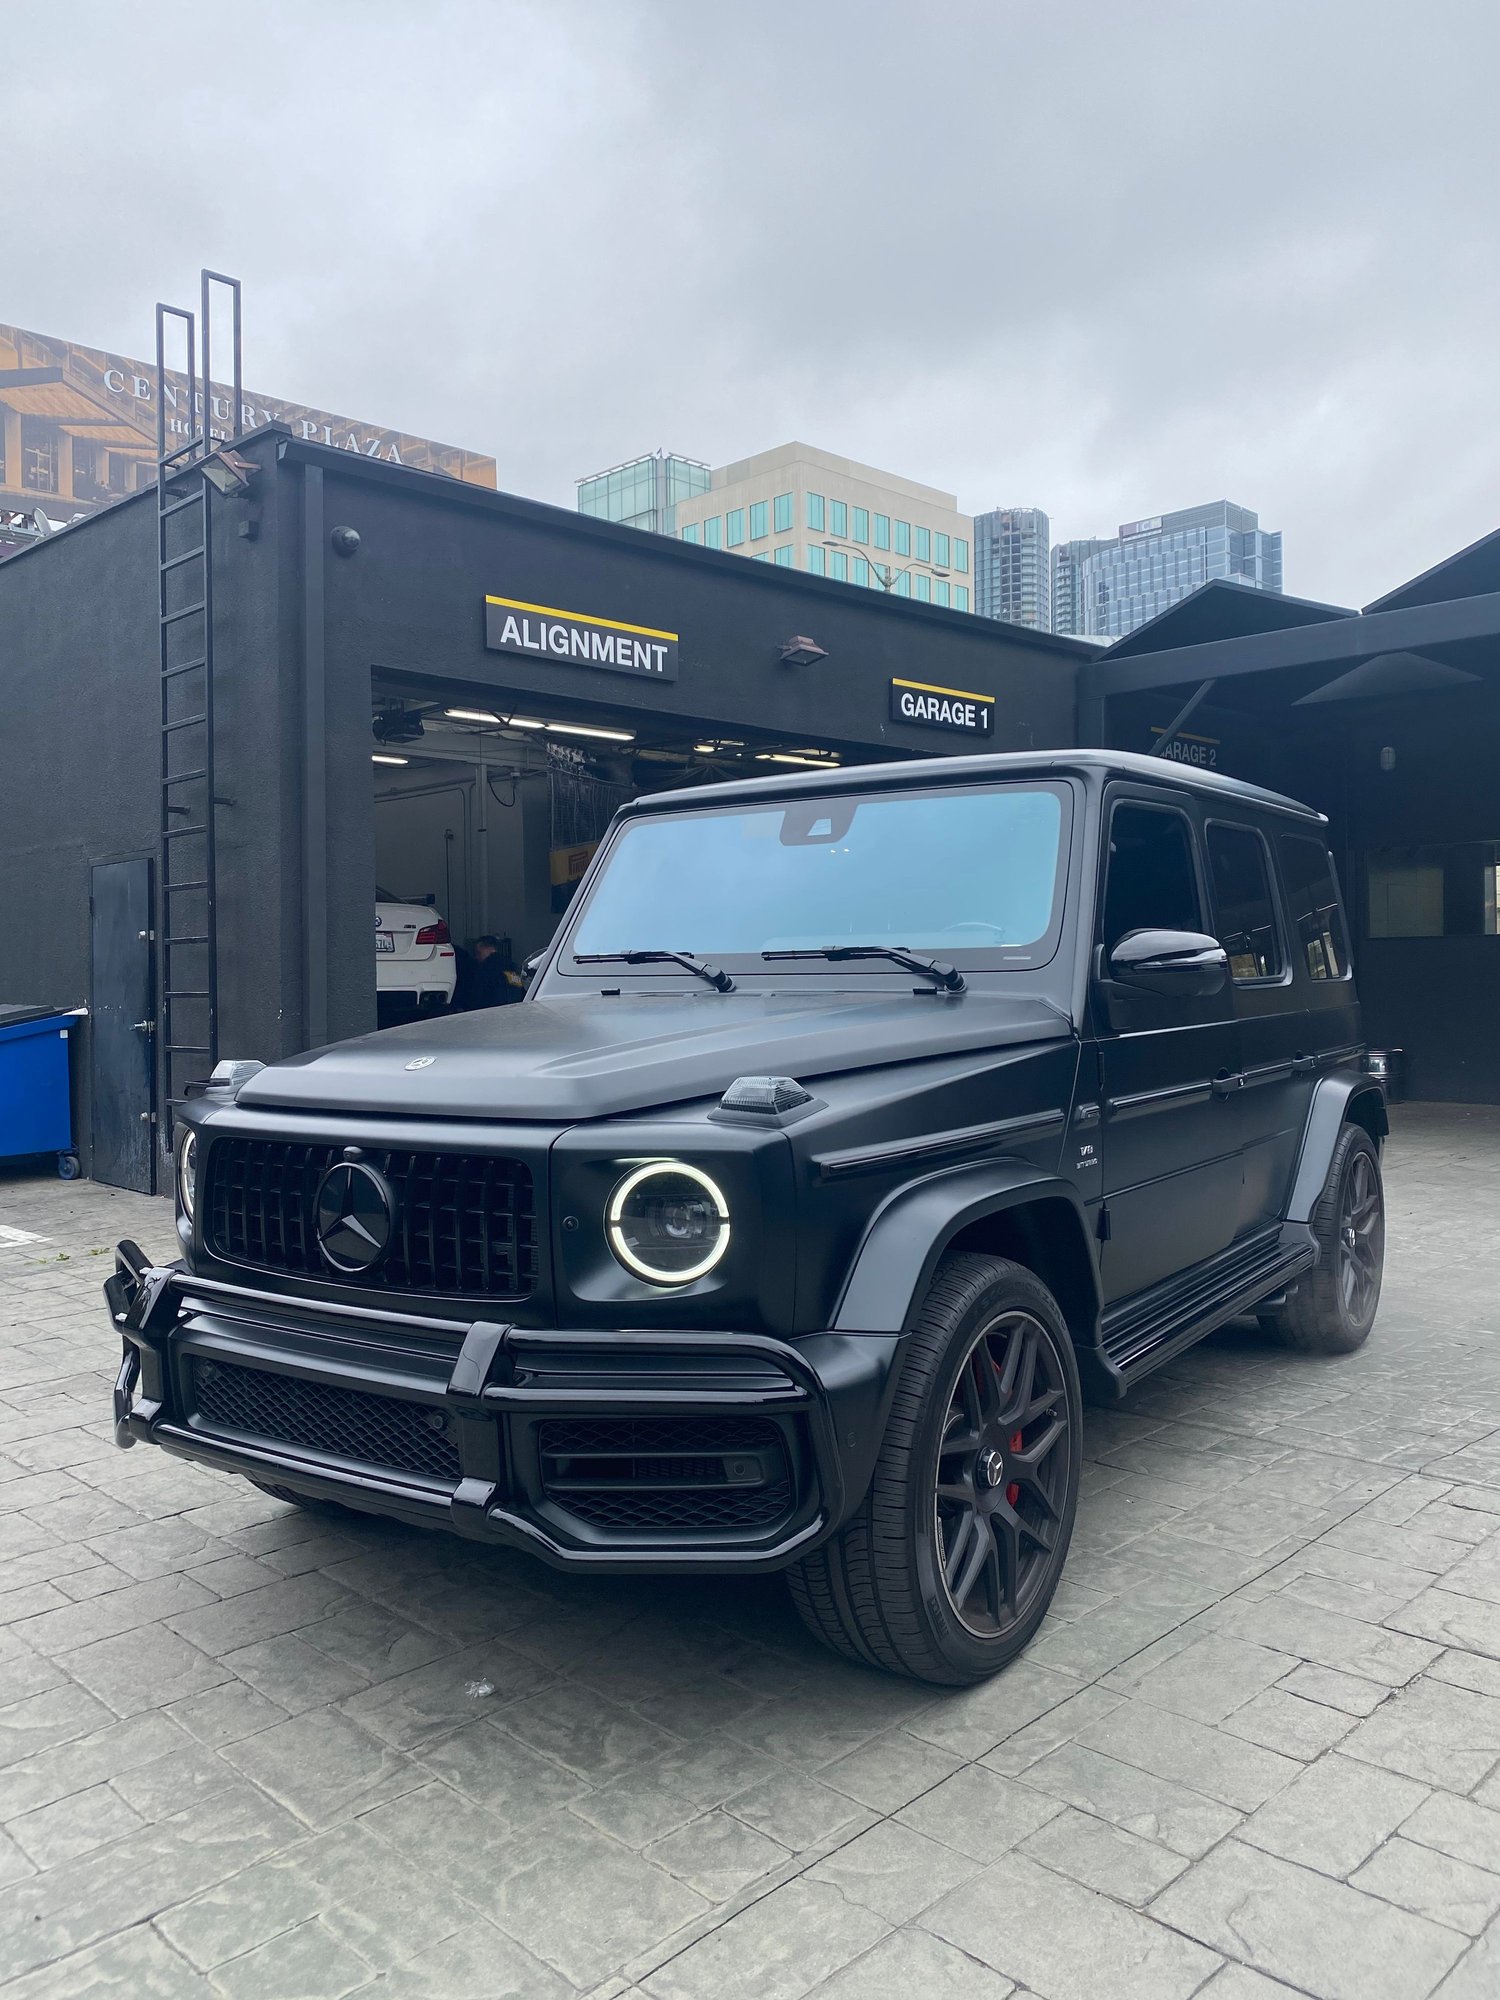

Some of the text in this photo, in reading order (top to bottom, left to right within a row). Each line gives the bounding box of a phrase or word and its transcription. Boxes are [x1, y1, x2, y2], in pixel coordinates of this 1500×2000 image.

[301, 419, 403, 464] PLAZA
[500, 615, 668, 672] ALIGNMENT
[901, 692, 988, 729] GARAGE 1
[1210, 749, 1217, 766] 2
